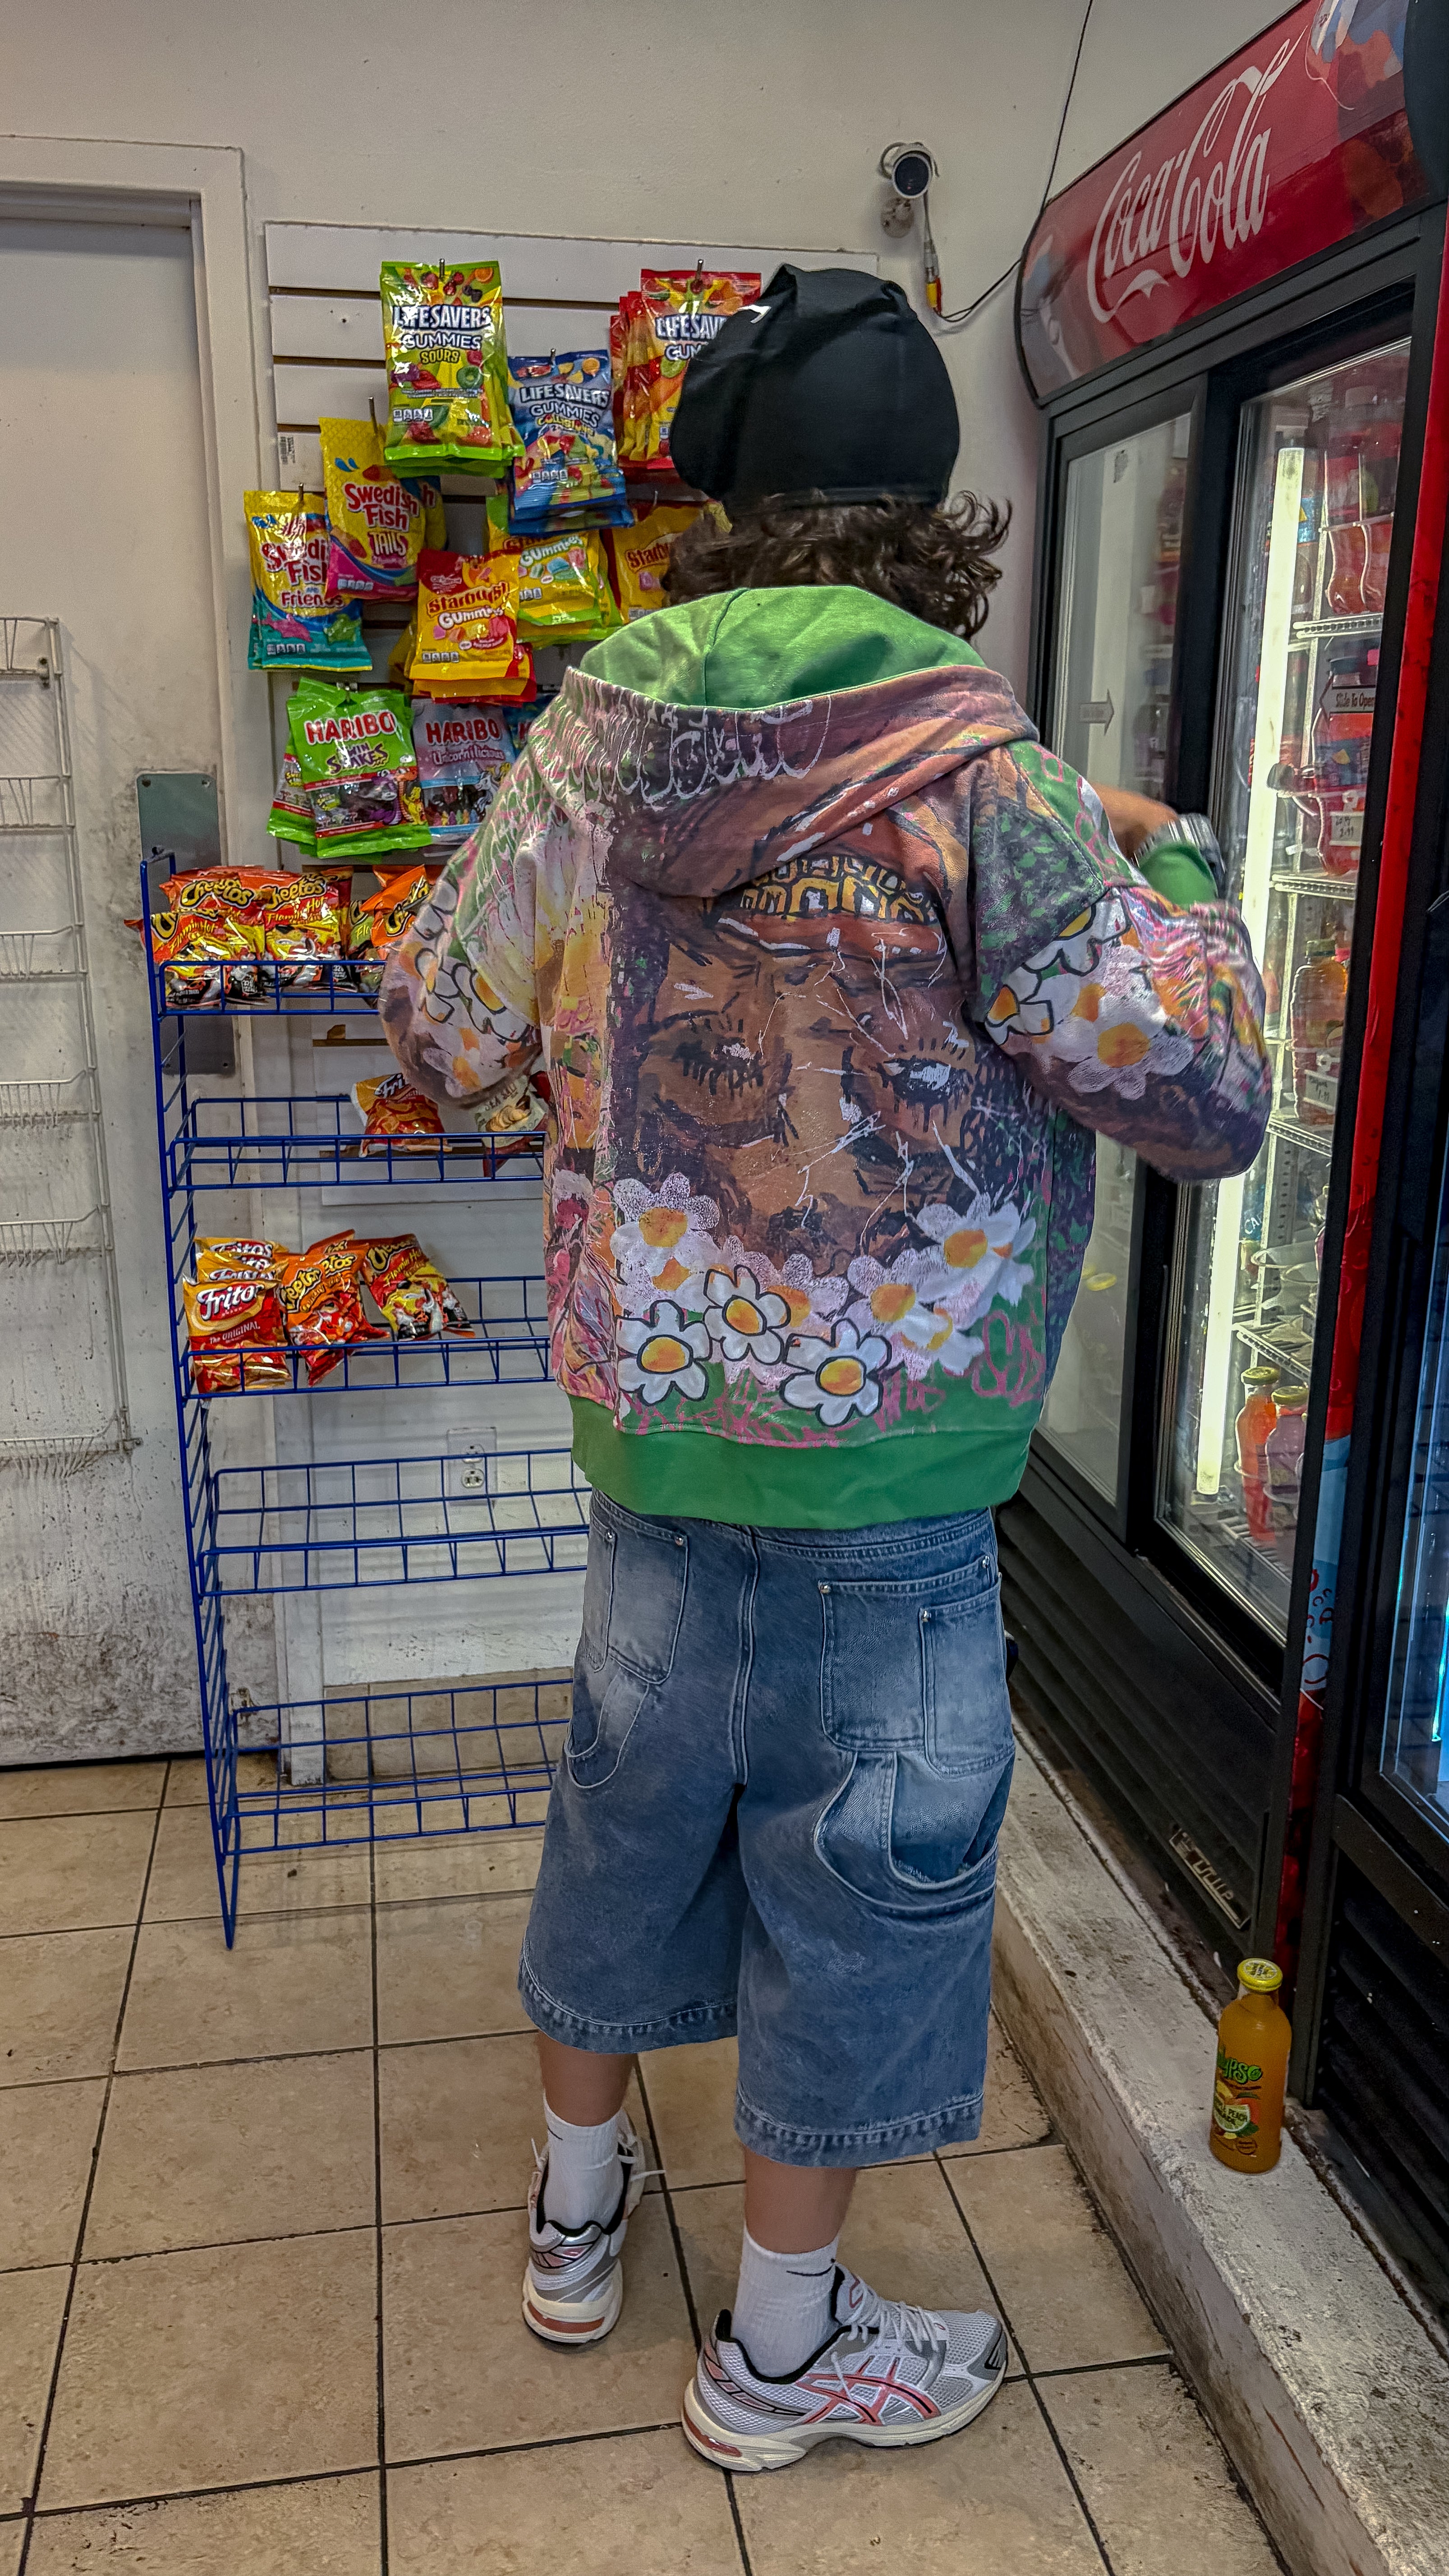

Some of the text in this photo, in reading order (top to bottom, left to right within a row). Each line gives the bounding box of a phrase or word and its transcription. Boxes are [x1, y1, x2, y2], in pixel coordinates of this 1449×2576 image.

[1087, 26, 1307, 322] Coca-Cola
[402, 333, 482, 350] GUMMIES
[421, 350, 460, 364] SOURS
[531, 402, 600, 428] GUMMIES
[344, 483, 418, 515] Swedish
[363, 504, 409, 530] Fish
[369, 532, 407, 556] TAILS
[305, 711, 396, 744] HARIBO
[426, 719, 500, 743] HARIBO
[327, 743, 388, 774] SAKES
[337, 743, 370, 757] WIN
[264, 880, 325, 909] heetos
[374, 1073, 404, 1099] Fri
